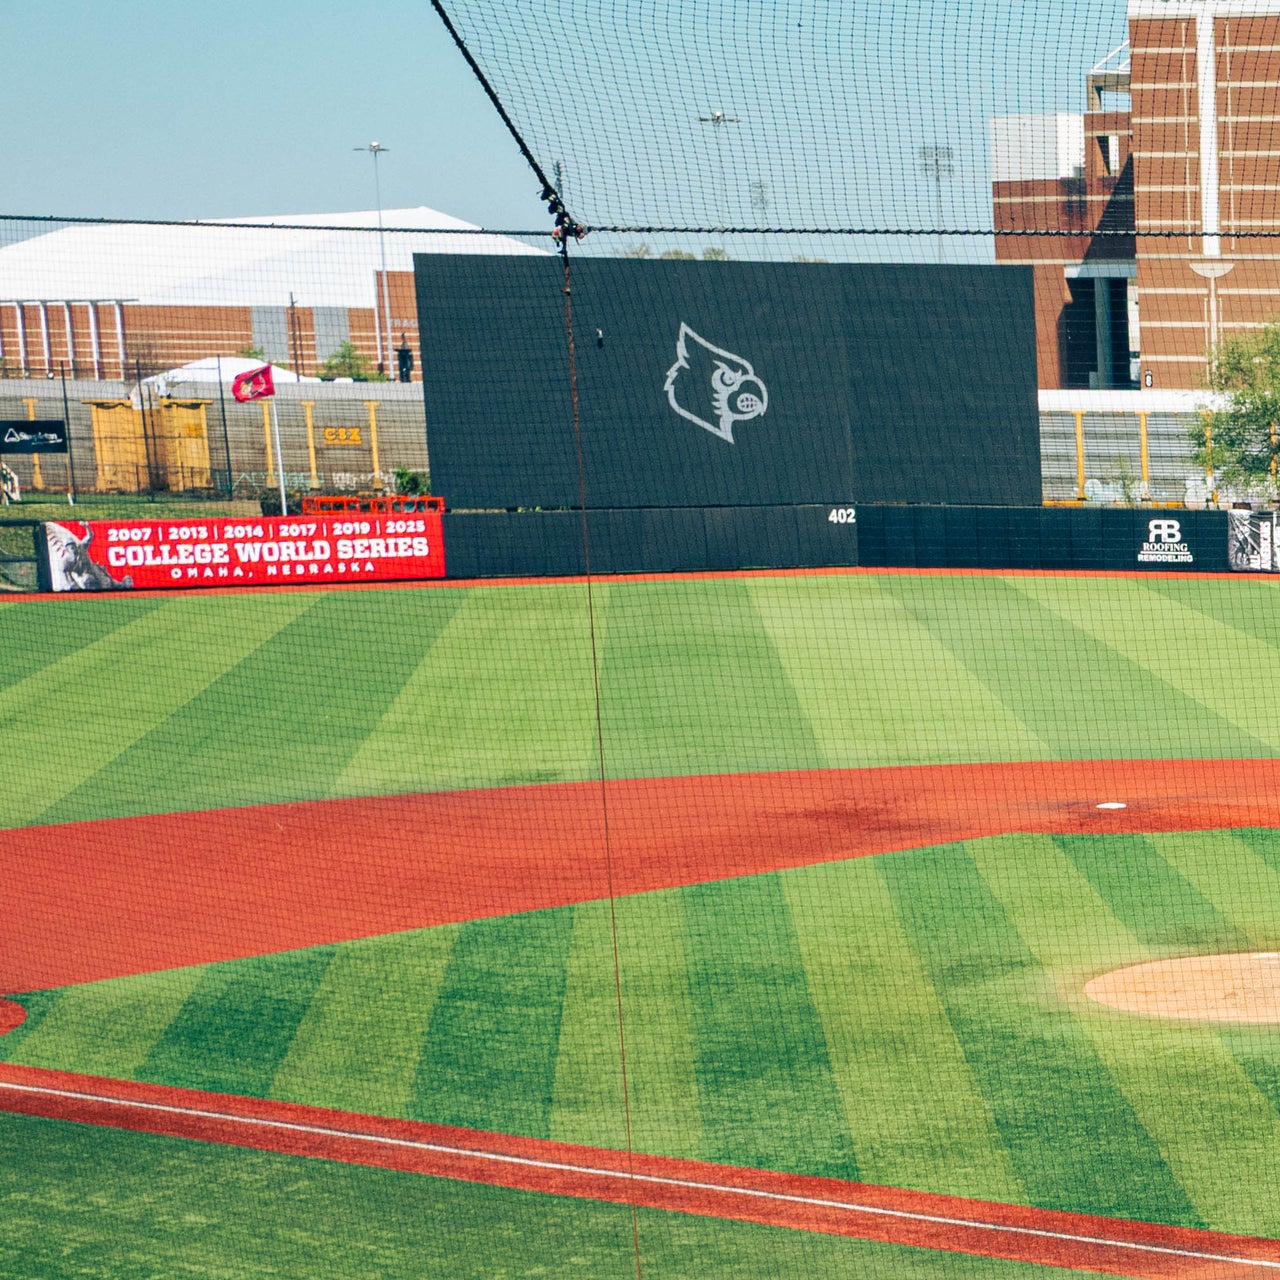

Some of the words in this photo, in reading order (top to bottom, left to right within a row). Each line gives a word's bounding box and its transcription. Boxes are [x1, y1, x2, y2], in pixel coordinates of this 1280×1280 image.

[828, 508, 856, 524] 402
[107, 527, 152, 542] 2007
[168, 525, 208, 540] 2013
[223, 524, 264, 539] 2014
[279, 522, 317, 537] 2017
[332, 521, 370, 535] 2019
[385, 520, 426, 534] 2025
[108, 543, 230, 567] COLLEGE
[234, 540, 331, 562] WORLD
[336, 537, 429, 559] SERIES
[1143, 542, 1188, 552] ROOFING
[1137, 554, 1194, 563] REMODELING
[170, 566, 253, 579] OMAHA,
[267, 561, 374, 576] NEBRASKA
